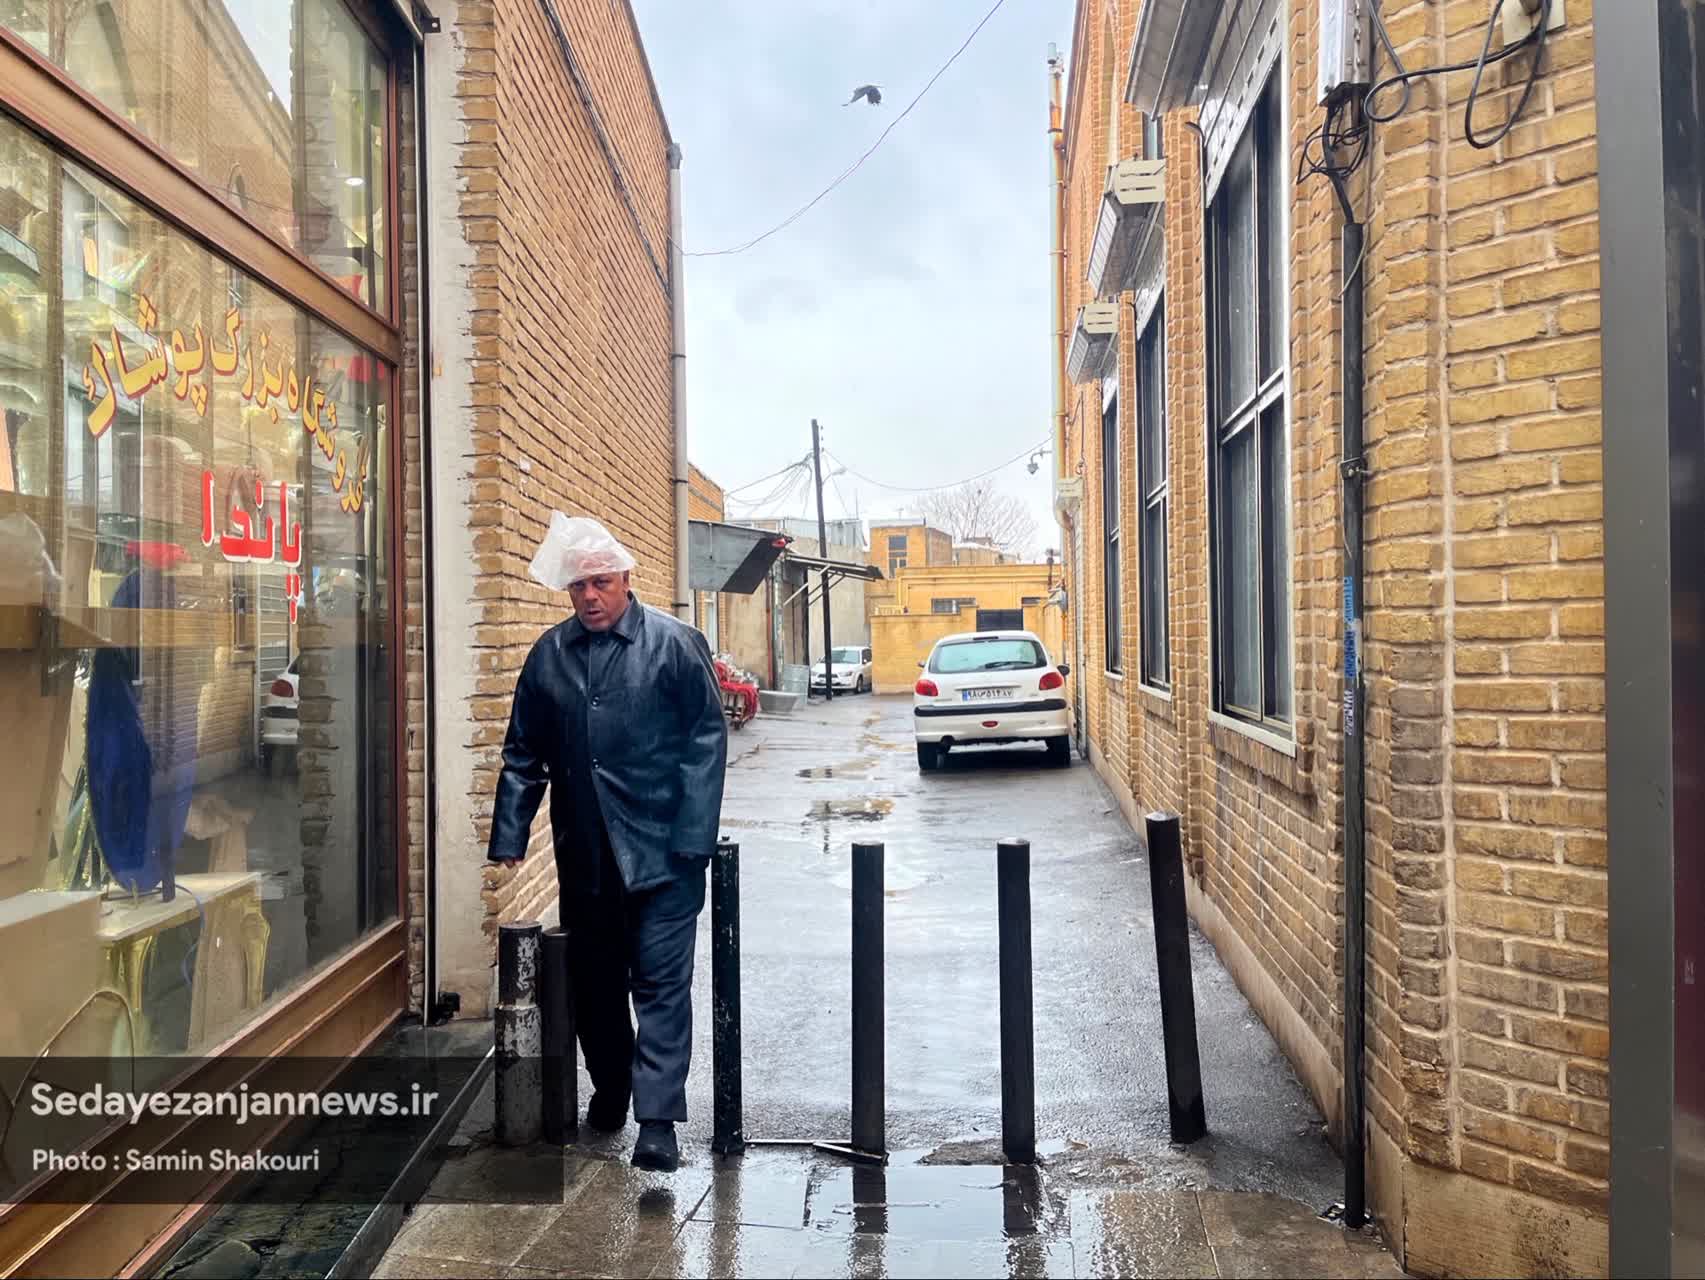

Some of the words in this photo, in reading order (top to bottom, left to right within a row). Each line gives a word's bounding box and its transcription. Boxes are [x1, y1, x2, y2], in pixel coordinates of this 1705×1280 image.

[83, 294, 208, 438] پوشاک
[210, 307, 284, 424] بزرگ
[201, 470, 301, 624] پاندا
